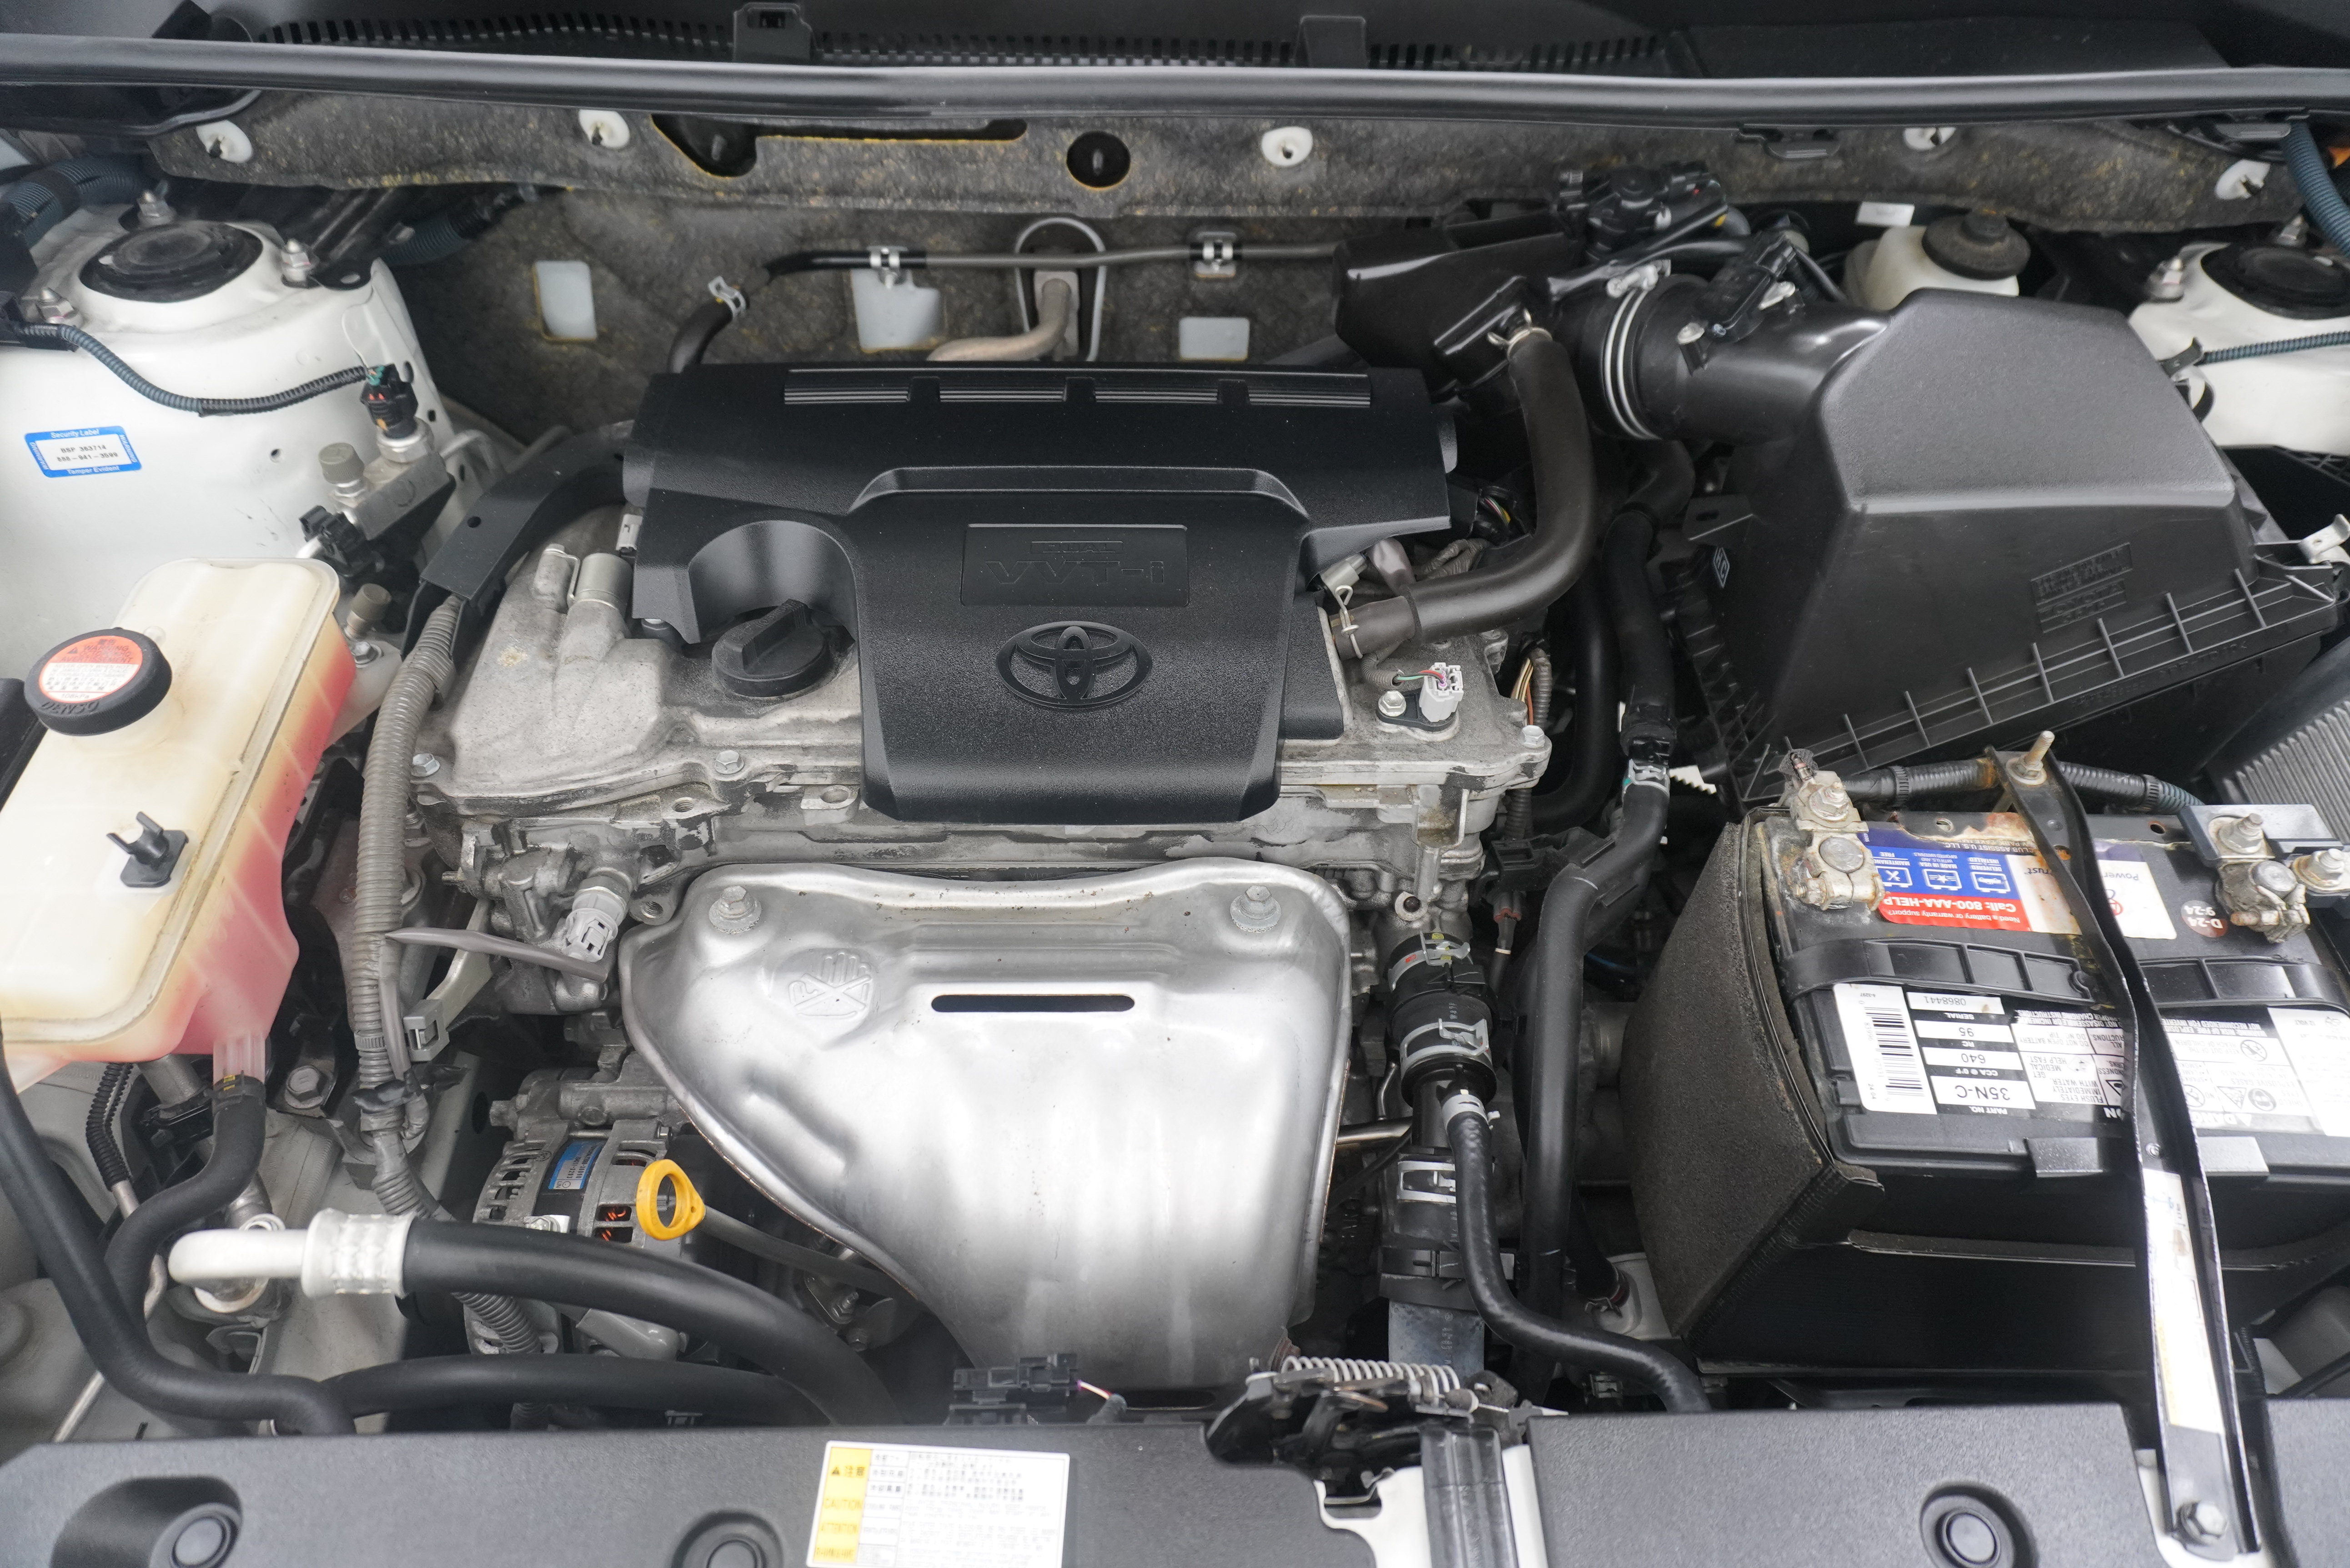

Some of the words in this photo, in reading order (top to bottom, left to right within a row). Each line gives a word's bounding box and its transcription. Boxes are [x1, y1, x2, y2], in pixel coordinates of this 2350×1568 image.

[50, 430, 78, 439] Security
[2103, 871, 2139, 880] Power
[1883, 895, 1982, 911] 800-AAA-HELP
[1984, 901, 2016, 912] Call:
[1887, 908, 1920, 917] support?
[1921, 910, 1954, 919] warranty
[2183, 905, 2216, 916] 9-24
[1964, 912, 1990, 921] battery
[2187, 916, 2224, 929] D-24
[1923, 995, 1966, 1006] 0868441
[1958, 1027, 1974, 1036] 95
[1960, 1053, 1986, 1064] 640
[2029, 1063, 2061, 1071] MEDICAL
[1954, 1084, 2011, 1101] 35N-C
[2051, 1085, 2100, 1096] IMMEDIATELY
[2080, 1095, 2104, 1103] FLUSH
